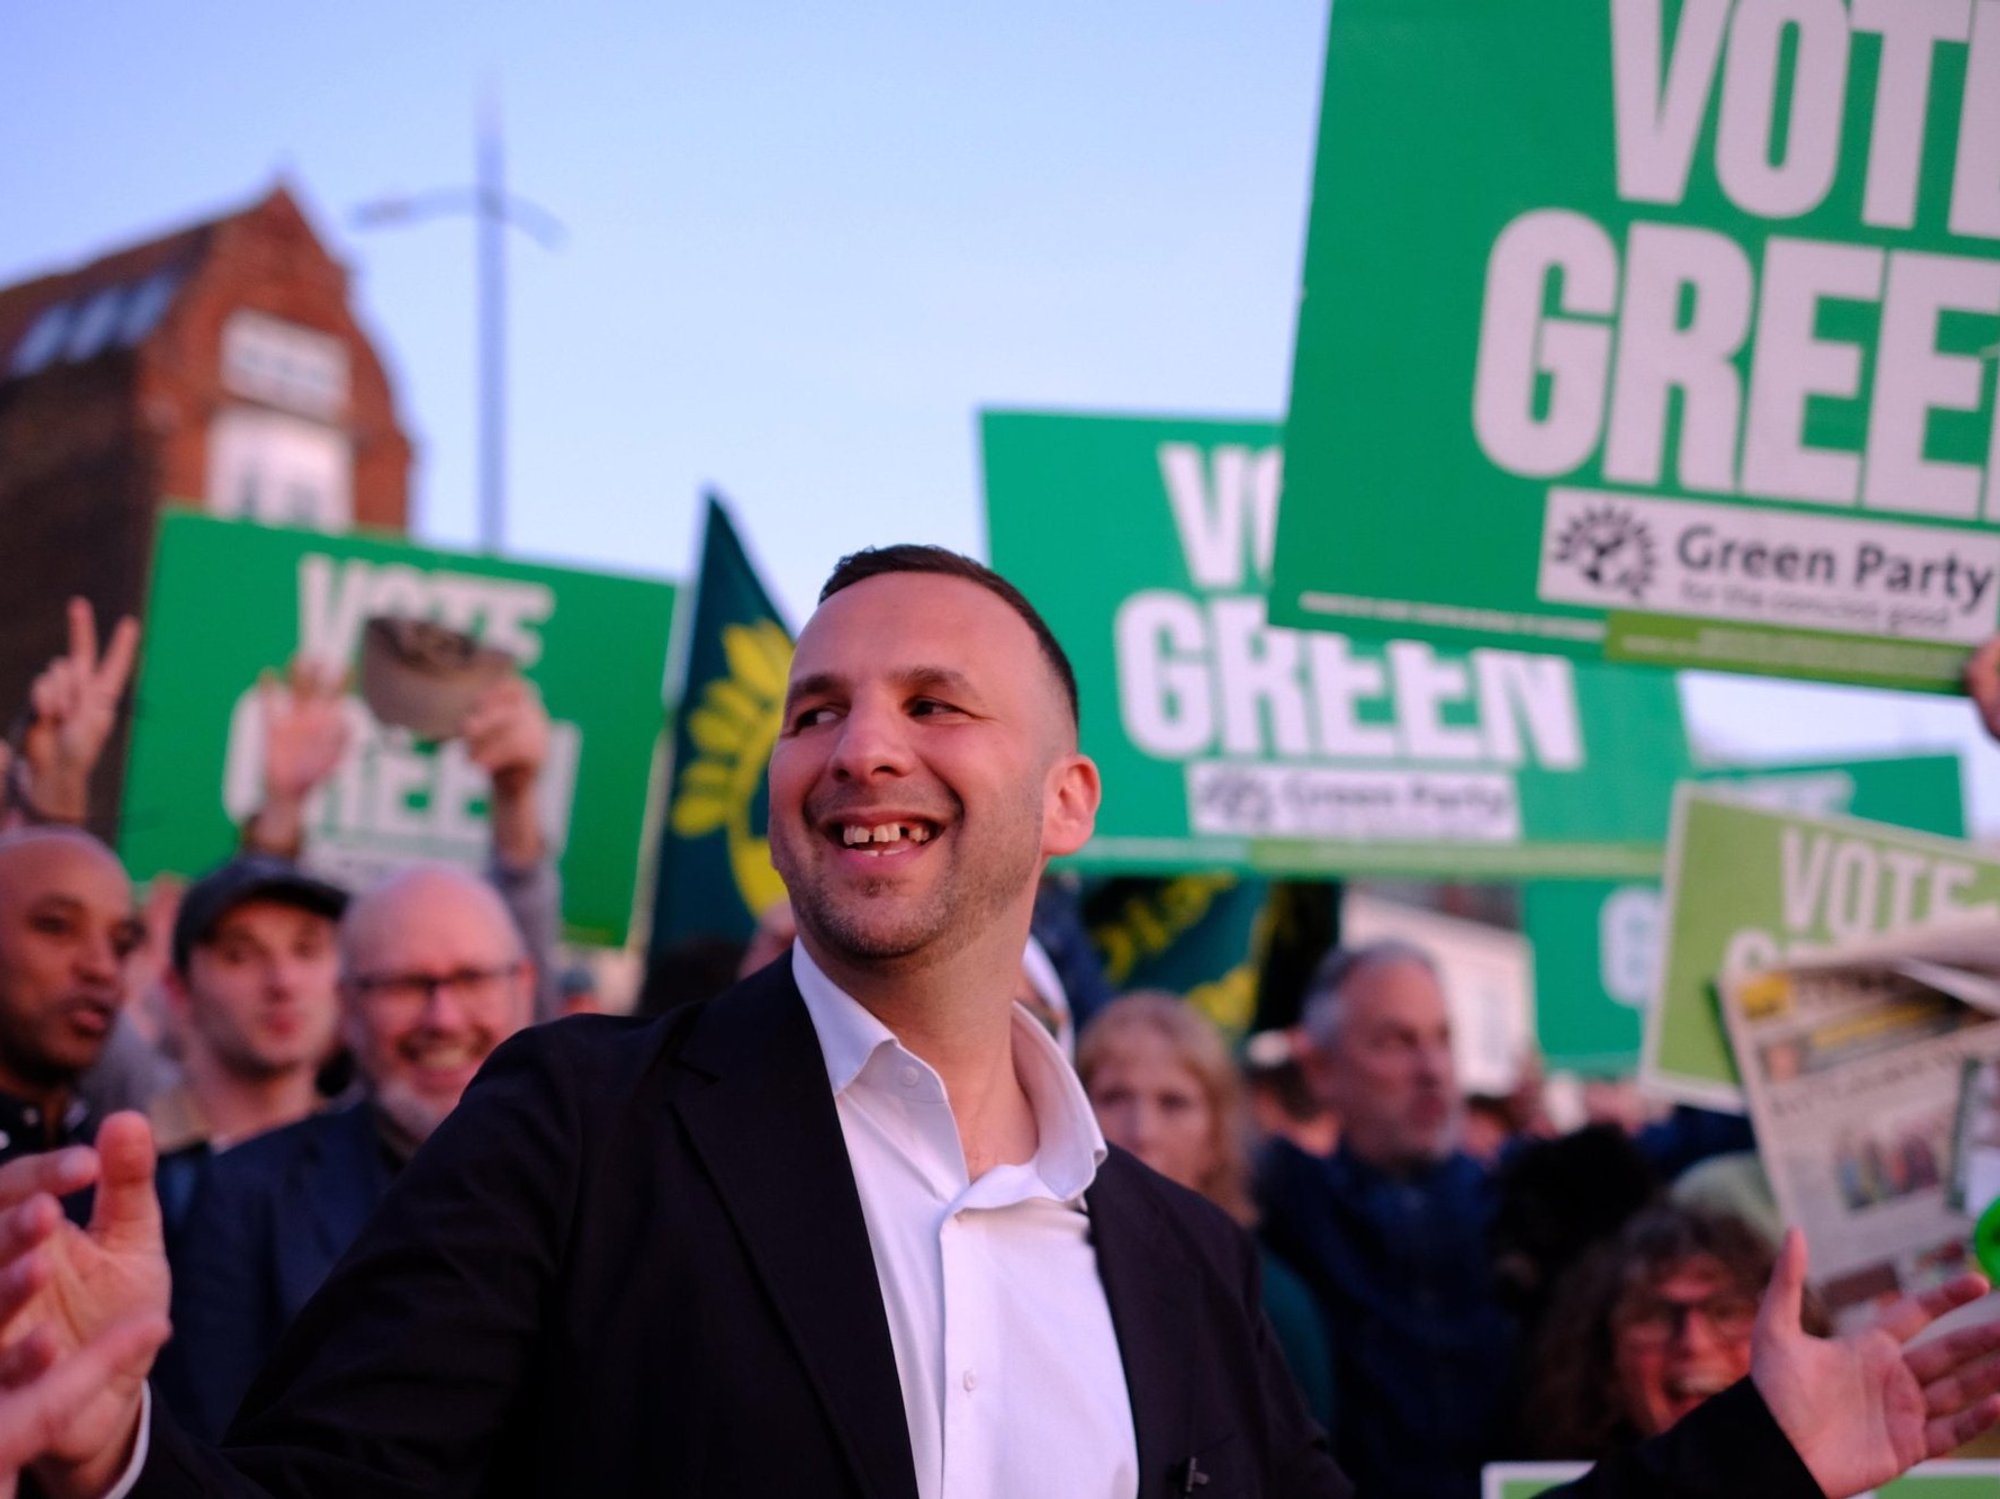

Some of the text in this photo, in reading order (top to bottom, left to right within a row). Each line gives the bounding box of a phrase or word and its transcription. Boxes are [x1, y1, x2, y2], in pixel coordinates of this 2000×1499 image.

[1472, 208, 2000, 523] GREE
[1676, 525, 1838, 584] Green
[1854, 543, 1995, 614] Party
[1115, 590, 1585, 772] GREEN
